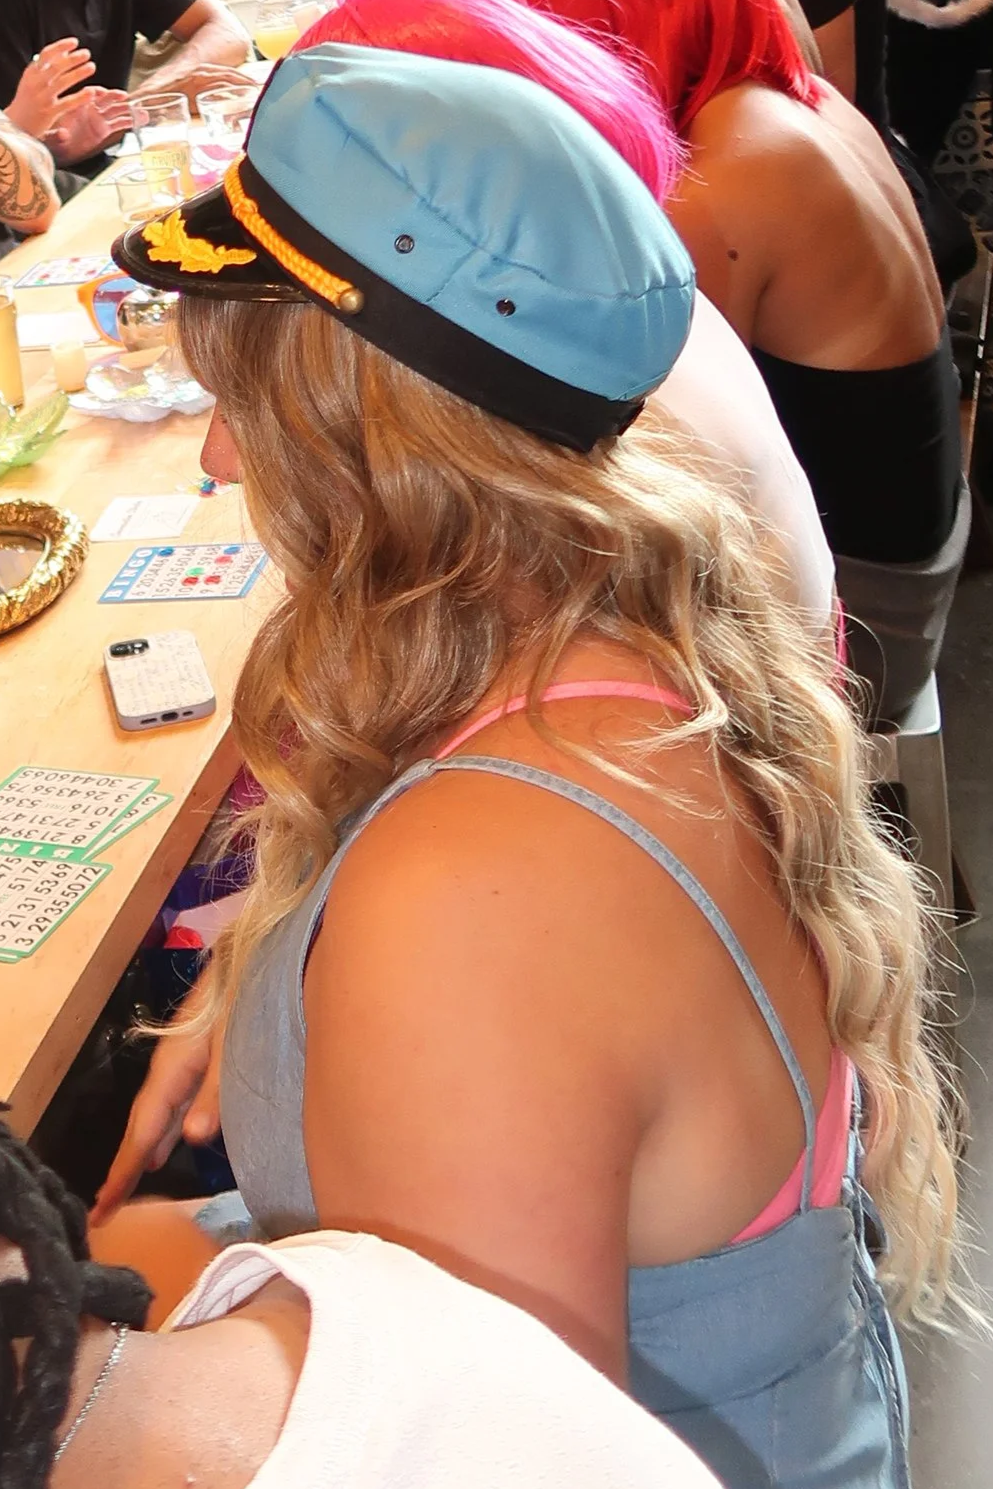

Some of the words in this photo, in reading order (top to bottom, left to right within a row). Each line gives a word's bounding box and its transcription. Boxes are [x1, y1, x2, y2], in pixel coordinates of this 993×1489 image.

[104, 549, 153, 598] BINGO
[19, 770, 44, 779] 65
[45, 772, 70, 782] 60
[71, 775, 96, 785] 44
[98, 777, 122, 788] 30
[3, 782, 30, 792] 75
[33, 785, 56, 795] 56
[127, 781, 142, 790] 7
[57, 788, 81, 798] 43
[84, 791, 107, 800] 26
[112, 793, 129, 803] 3
[18, 799, 41, 808] 53
[70, 804, 90, 814] 16
[94, 807, 117, 817] 10
[3, 811, 26, 822] 47
[30, 815, 53, 825] 31
[53, 818, 79, 827] 27
[84, 821, 100, 830] 5
[12, 828, 39, 839] 39
[42, 831, 66, 842] 21
[71, 834, 87, 844] 8
[7, 878, 32, 891] 51
[23, 860, 47, 874] 74
[1, 914, 25, 928] 21
[17, 897, 42, 911] 31
[34, 880, 59, 894] 53
[51, 864, 72, 878] 69
[15, 938, 34, 946] 3
[28, 917, 52, 933] 29
[44, 900, 70, 915] 35
[61, 884, 85, 898] 50
[75, 867, 102, 881] 72
